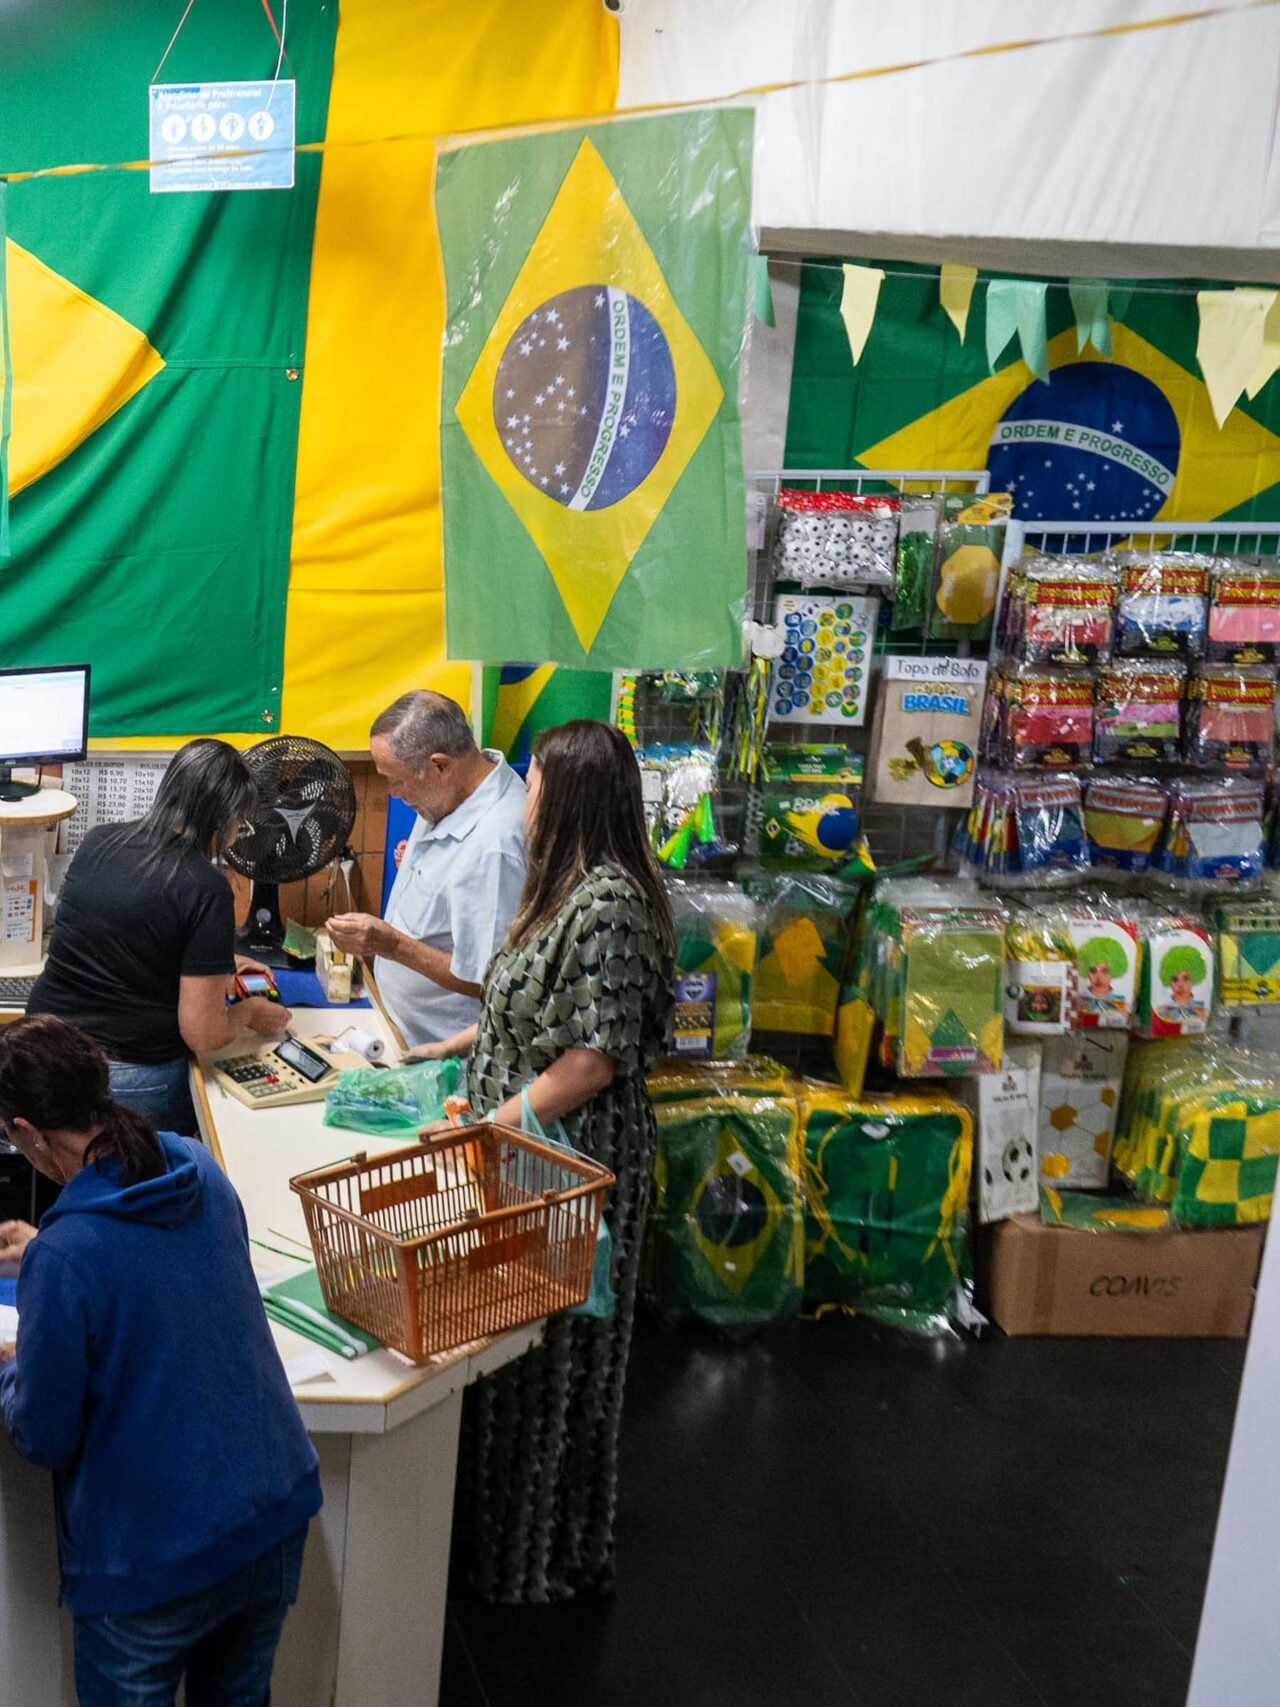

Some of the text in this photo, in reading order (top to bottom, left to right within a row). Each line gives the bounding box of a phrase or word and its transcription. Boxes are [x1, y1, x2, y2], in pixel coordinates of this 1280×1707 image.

[580, 299, 627, 498] ORDEM E PROGRESSO
[1000, 424, 1170, 486] ORDEM E PROGRESSO
[896, 659, 929, 677] Topo
[950, 661, 980, 677] Bolo
[903, 693, 970, 716] BRASIL
